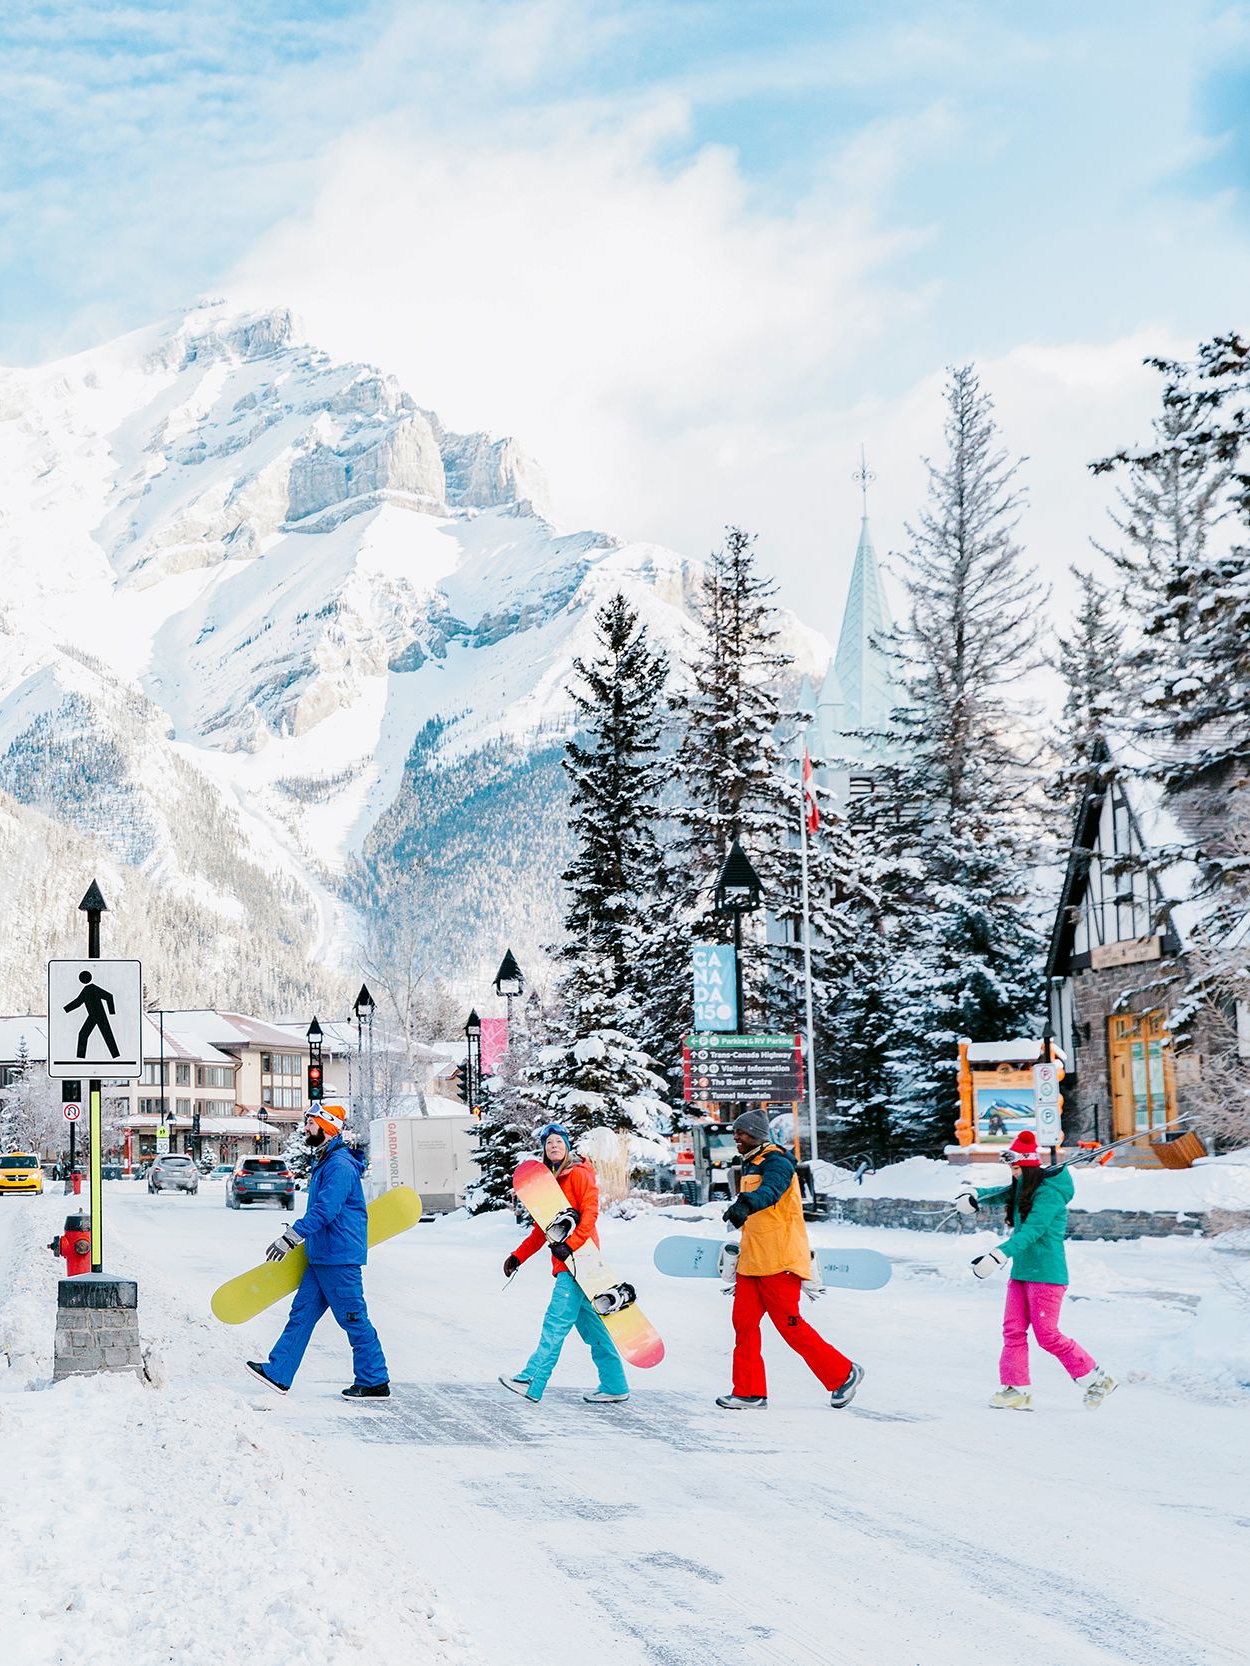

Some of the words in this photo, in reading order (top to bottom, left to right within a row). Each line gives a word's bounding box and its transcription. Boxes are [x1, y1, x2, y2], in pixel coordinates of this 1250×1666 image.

[694, 1004, 732, 1020] 150
[721, 1037, 749, 1046] Parking
[754, 1037, 765, 1045] RV
[766, 1037, 793, 1046] Parking
[710, 1051, 759, 1059] Trans-Canada
[761, 1051, 792, 1060] Highway
[726, 1078, 746, 1086] Banff
[387, 1123, 399, 1188] GARDAWORLD
